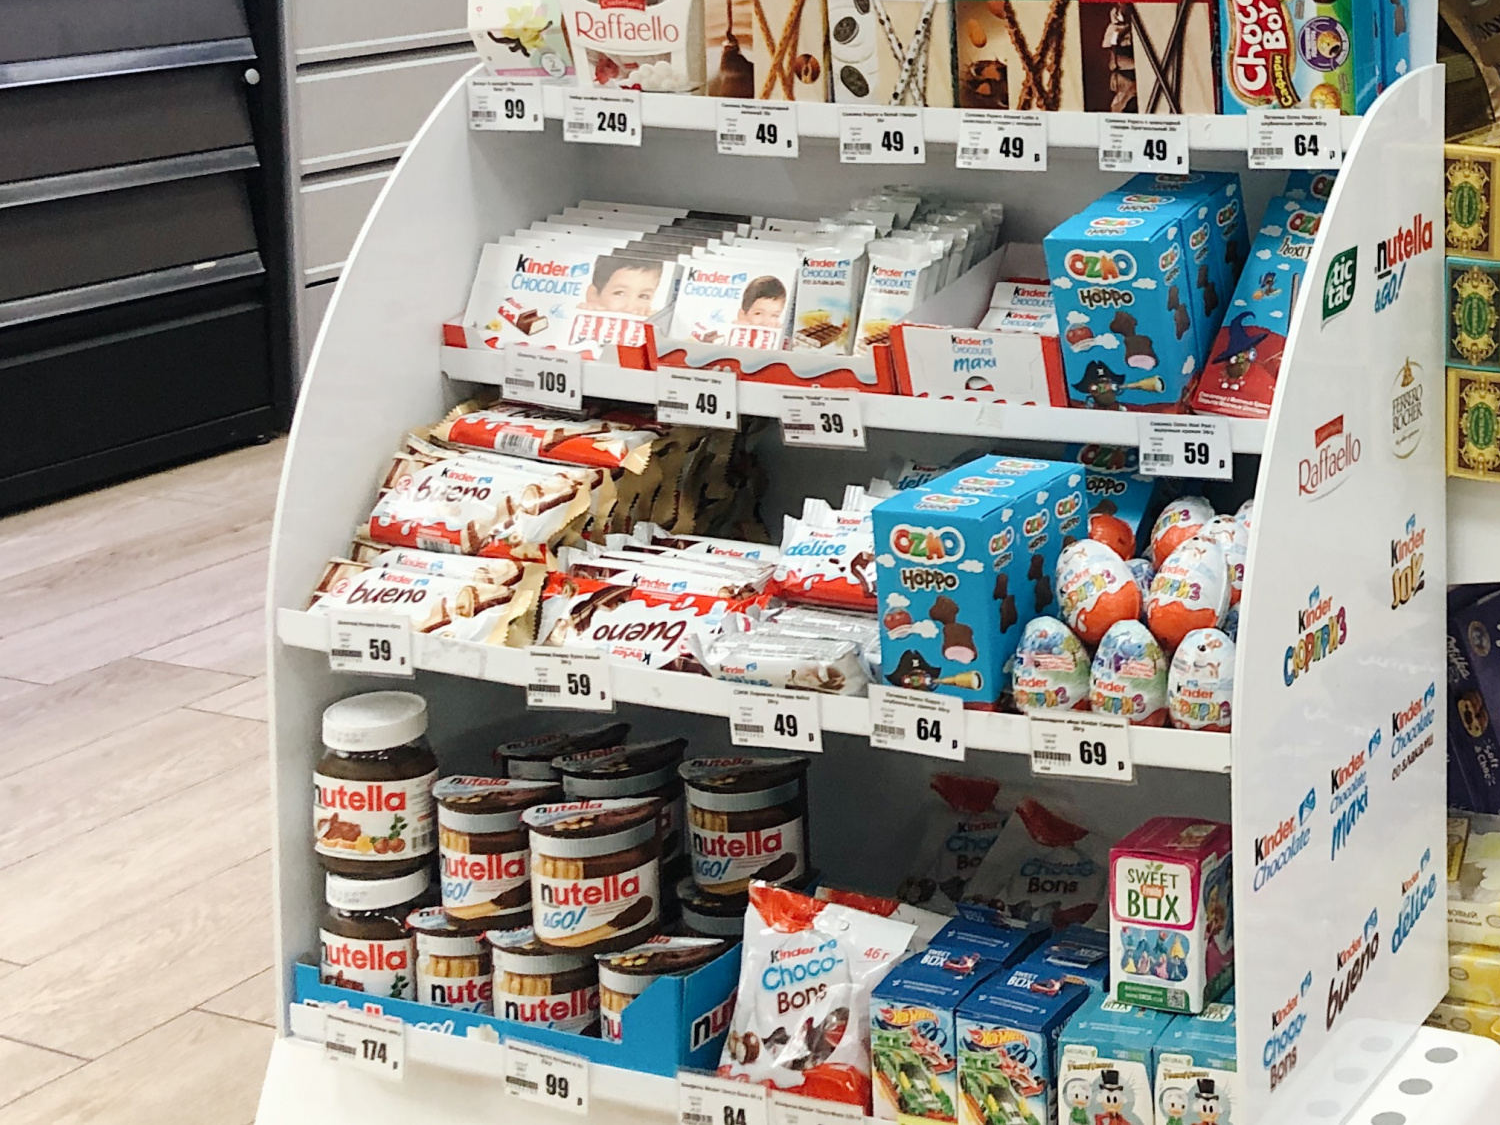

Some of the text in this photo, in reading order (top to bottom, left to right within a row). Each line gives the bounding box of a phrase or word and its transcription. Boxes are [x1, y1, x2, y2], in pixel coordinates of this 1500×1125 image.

[575, 11, 679, 43] Raffaello
[1258, 1, 1288, 52] Boy
[504, 99, 526, 120] 99
[597, 111, 628, 133] 249
[756, 123, 778, 145] 49
[881, 131, 904, 152] 49
[999, 136, 1024, 159] 49
[1143, 139, 1168, 161] 49
[1294, 134, 1320, 157] 64
[1377, 213, 1433, 273] nutella
[515, 253, 570, 277] Kinder
[801, 268, 848, 280] CHOCOLATE
[803, 257, 837, 268] Kinder
[872, 264, 904, 277] Kinder
[1067, 253, 1134, 280] OZMO
[1332, 256, 1354, 286] tic
[511, 274, 583, 296] CHOCOLATE
[687, 266, 730, 285] Kinder
[684, 281, 742, 300] CHOCOLATE
[1013, 286, 1046, 299] Kinder
[1328, 280, 1352, 310] tac
[951, 335, 982, 347] Kinder
[953, 356, 997, 373] maxi
[537, 370, 567, 393] 109
[695, 392, 718, 415] 49
[1392, 383, 1424, 417] FERRERO
[819, 412, 844, 434] 39
[1392, 401, 1423, 434] ROCHER
[1183, 442, 1210, 465] 59
[1298, 432, 1362, 497] Raffaello
[440, 467, 477, 483] Kinder
[413, 475, 491, 503] bueno
[891, 528, 963, 562] OZMO
[1391, 528, 1426, 568] Kinder
[379, 571, 414, 585] Kinder
[631, 573, 672, 592] Kinder
[1391, 552, 1425, 610] JOY
[346, 580, 427, 604] bueno
[1298, 595, 1333, 635] Kinder
[592, 619, 688, 652] bueno
[1283, 606, 1347, 687] СЮРПРИЗ
[368, 638, 392, 661] 59
[611, 645, 652, 666] Kinder
[566, 672, 592, 696] 59
[773, 713, 799, 737] 49
[1392, 697, 1423, 737] Kinder
[915, 717, 942, 743] 64
[1391, 708, 1435, 759] Chocolate
[1079, 740, 1108, 766] 69
[449, 776, 510, 787] nutella
[1331, 750, 1365, 795] Kinder
[1330, 770, 1368, 815] Chocolate
[535, 800, 603, 815] nutella
[1331, 785, 1369, 862] maxi
[693, 829, 783, 859] nutella
[1254, 815, 1296, 867] Kinder
[1253, 827, 1311, 893] Chocolate
[1027, 877, 1079, 894] Bons
[1126, 867, 1180, 890] SWEET
[540, 875, 641, 907] nutella
[1127, 888, 1181, 923] BOX
[542, 907, 588, 933] &GO!
[769, 945, 816, 964] Kinder
[863, 946, 881, 959] 46
[920, 953, 946, 968] BOX
[1336, 935, 1362, 972] Kinder
[761, 955, 844, 991] Choco-
[1006, 976, 1034, 989] BOX
[1326, 931, 1380, 1032] bueno
[777, 981, 828, 1015] Bons
[1272, 993, 1299, 1031] Kinder
[361, 1039, 388, 1064] 174
[1269, 1045, 1297, 1093] Bons
[545, 1073, 570, 1099] 99
